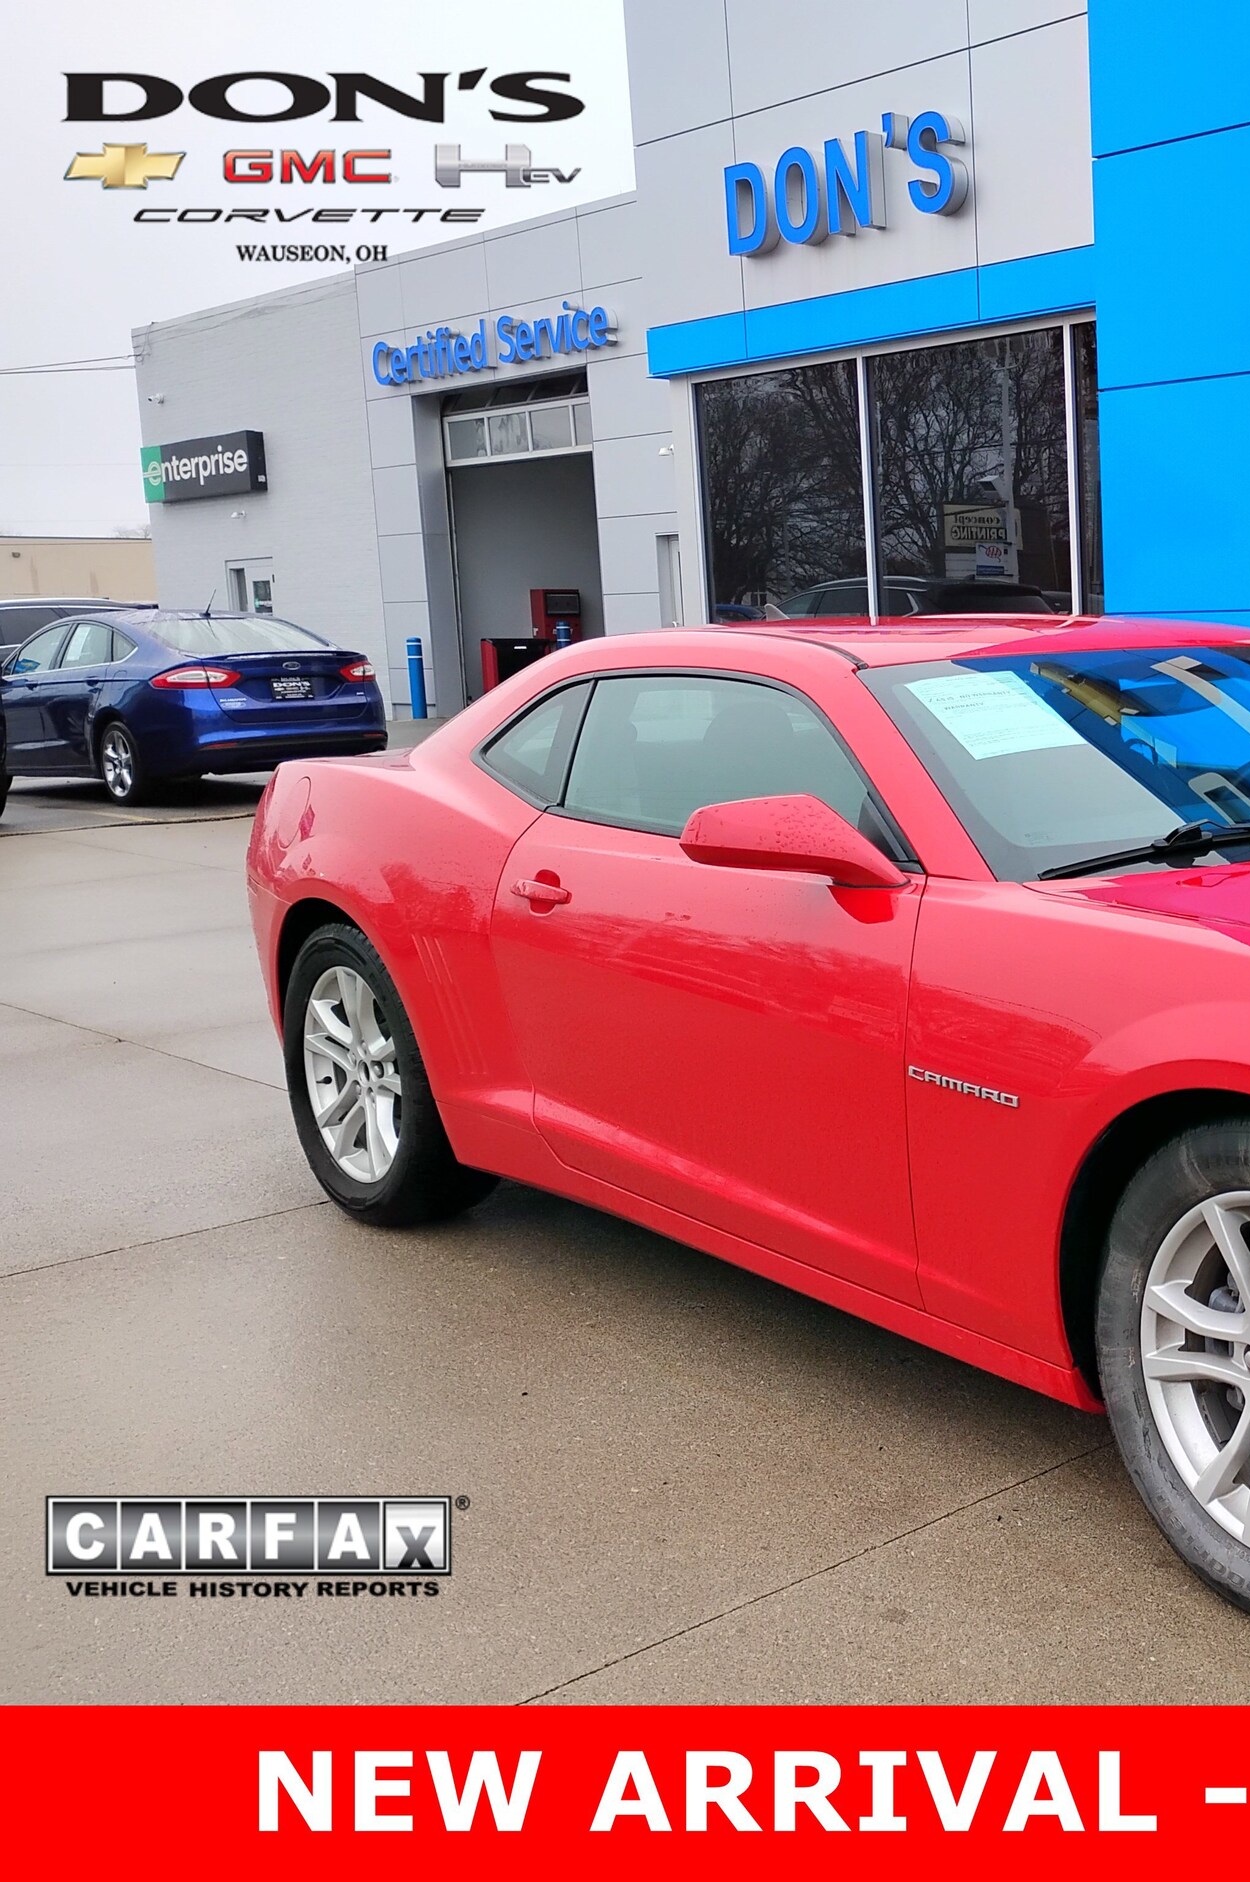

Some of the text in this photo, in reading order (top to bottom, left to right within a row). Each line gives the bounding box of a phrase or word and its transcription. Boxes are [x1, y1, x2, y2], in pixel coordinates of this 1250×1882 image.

[724, 111, 962, 256] DON'S
[372, 300, 609, 386] Certified Service
[144, 444, 248, 487] enterprise
[908, 1064, 1020, 1108] CAMARO
